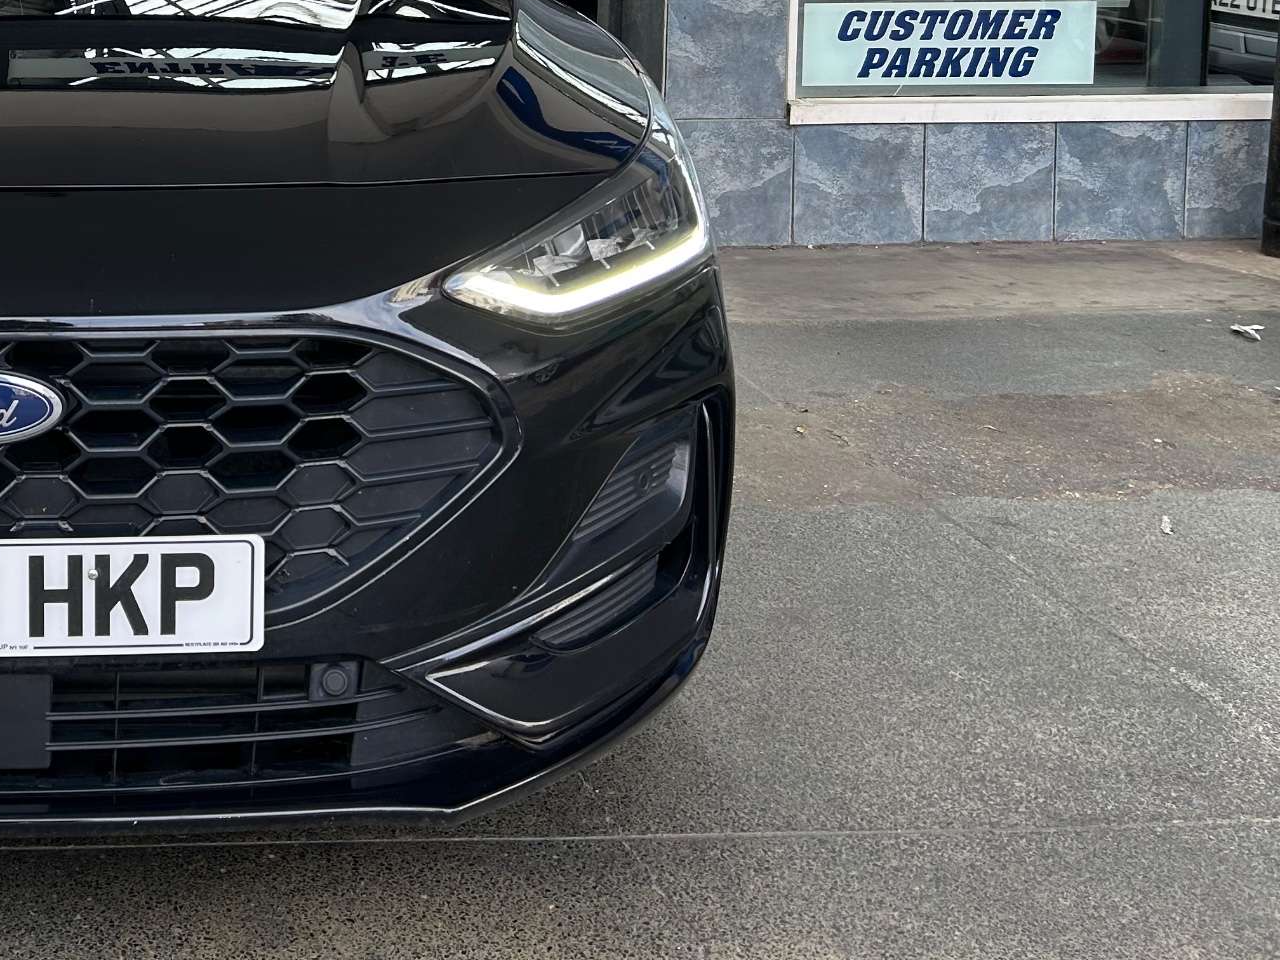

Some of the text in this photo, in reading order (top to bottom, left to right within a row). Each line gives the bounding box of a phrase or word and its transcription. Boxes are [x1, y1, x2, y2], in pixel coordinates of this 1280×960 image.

[838, 10, 1061, 41] CUSTOMER
[857, 47, 1039, 78] PARKING
[28, 553, 215, 638] HKP
